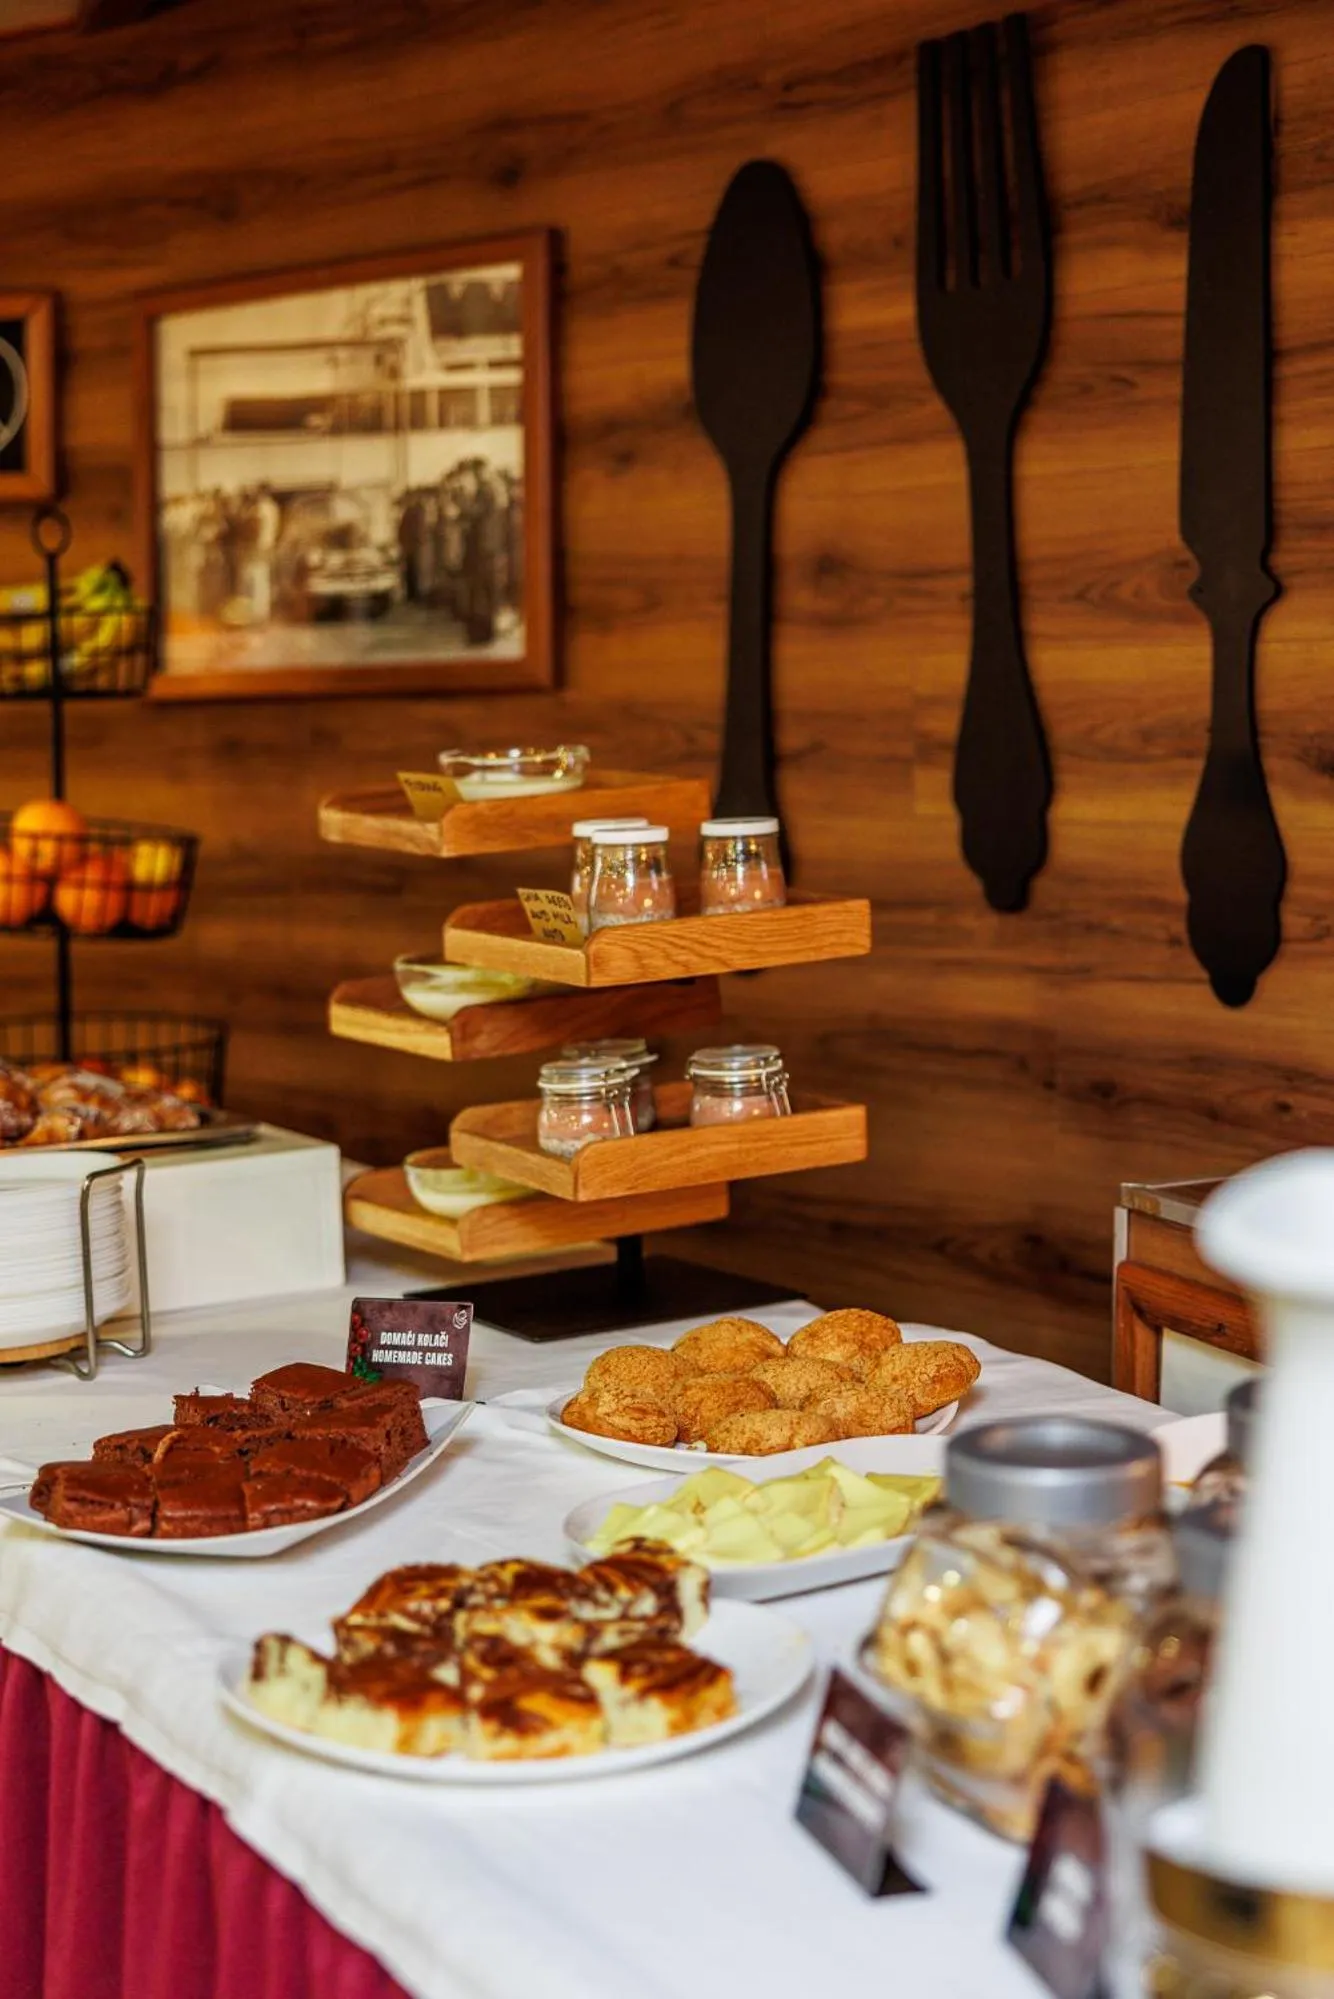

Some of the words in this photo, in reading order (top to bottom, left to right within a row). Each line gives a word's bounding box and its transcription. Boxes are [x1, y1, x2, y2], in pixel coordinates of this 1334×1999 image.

[380, 1330, 416, 1346] DOMAĆI
[417, 1331, 449, 1348] KOLAČI
[372, 1349, 423, 1365] HOMEMADE
[425, 1352, 454, 1366] CAKES
